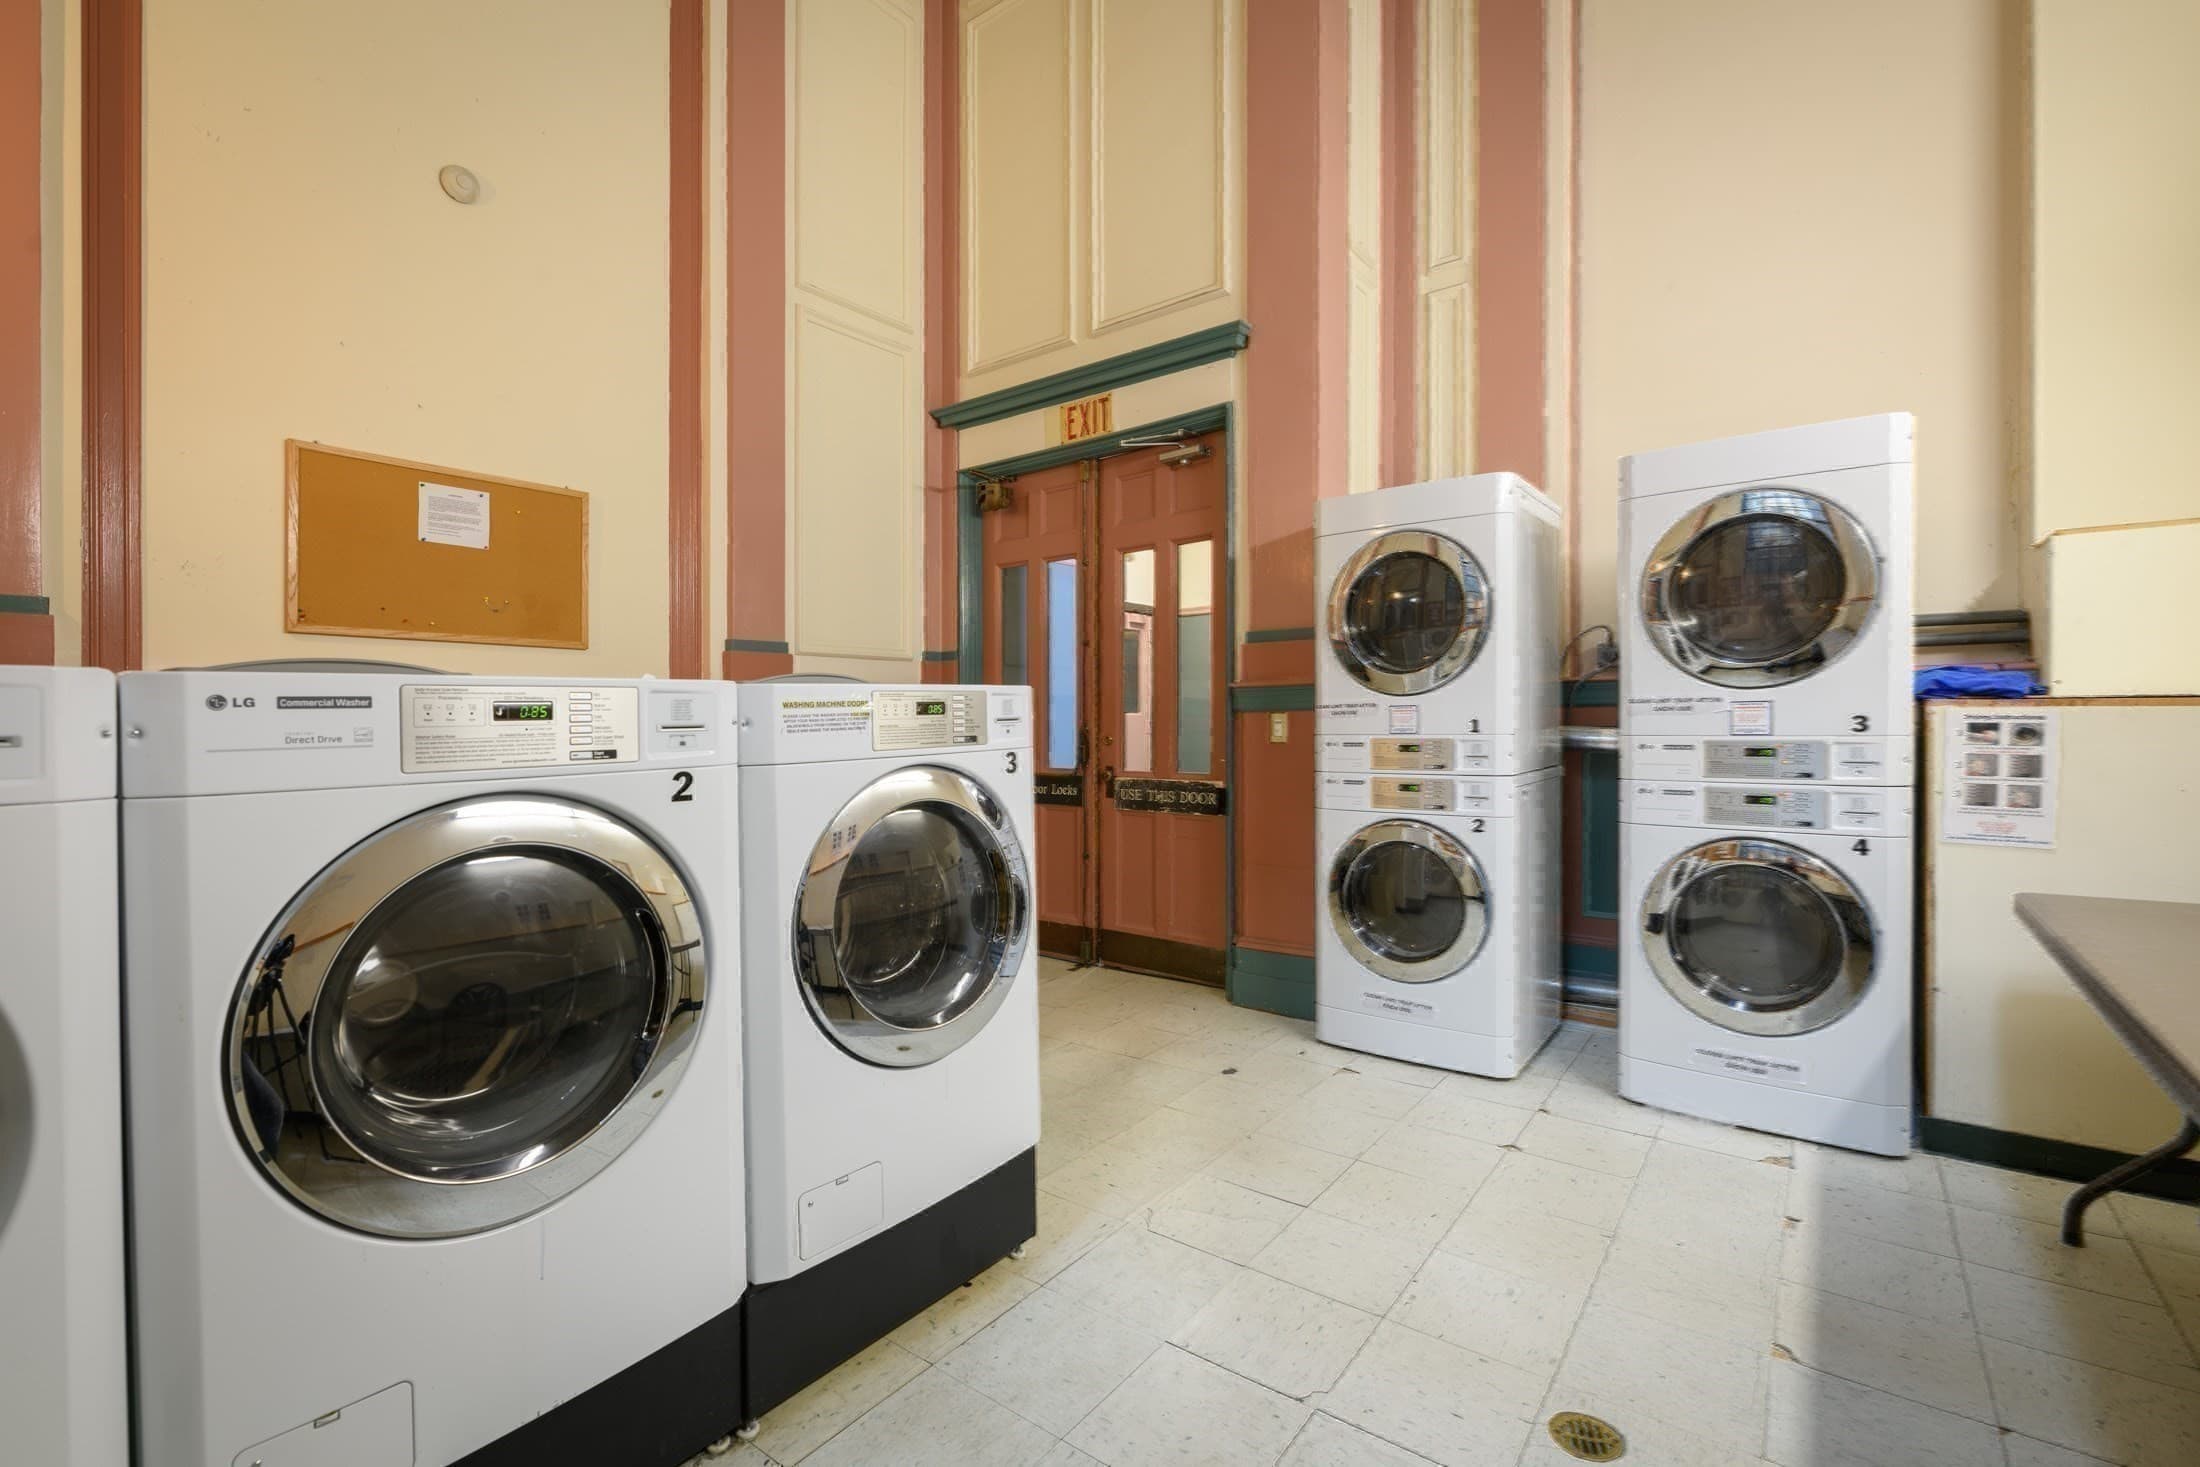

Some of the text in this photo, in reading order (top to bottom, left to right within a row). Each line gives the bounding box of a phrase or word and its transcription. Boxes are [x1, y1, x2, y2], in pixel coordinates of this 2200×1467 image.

[1066, 396, 1110, 441] EXIT
[232, 697, 256, 708] LG
[279, 698, 370, 707] Commercial Washer
[783, 701, 815, 709] WASHING
[816, 700, 845, 708] MACHINE
[1468, 719, 1480, 732] 1
[1851, 714, 1870, 733] 3
[285, 735, 343, 744] Direct Drive
[1005, 751, 1017, 774] 3
[671, 771, 694, 802] 2
[1051, 783, 1078, 796] Locks
[1120, 788, 1217, 805] USE THIS DOOR
[1472, 819, 1486, 832] 2
[1851, 839, 1871, 856] 4
